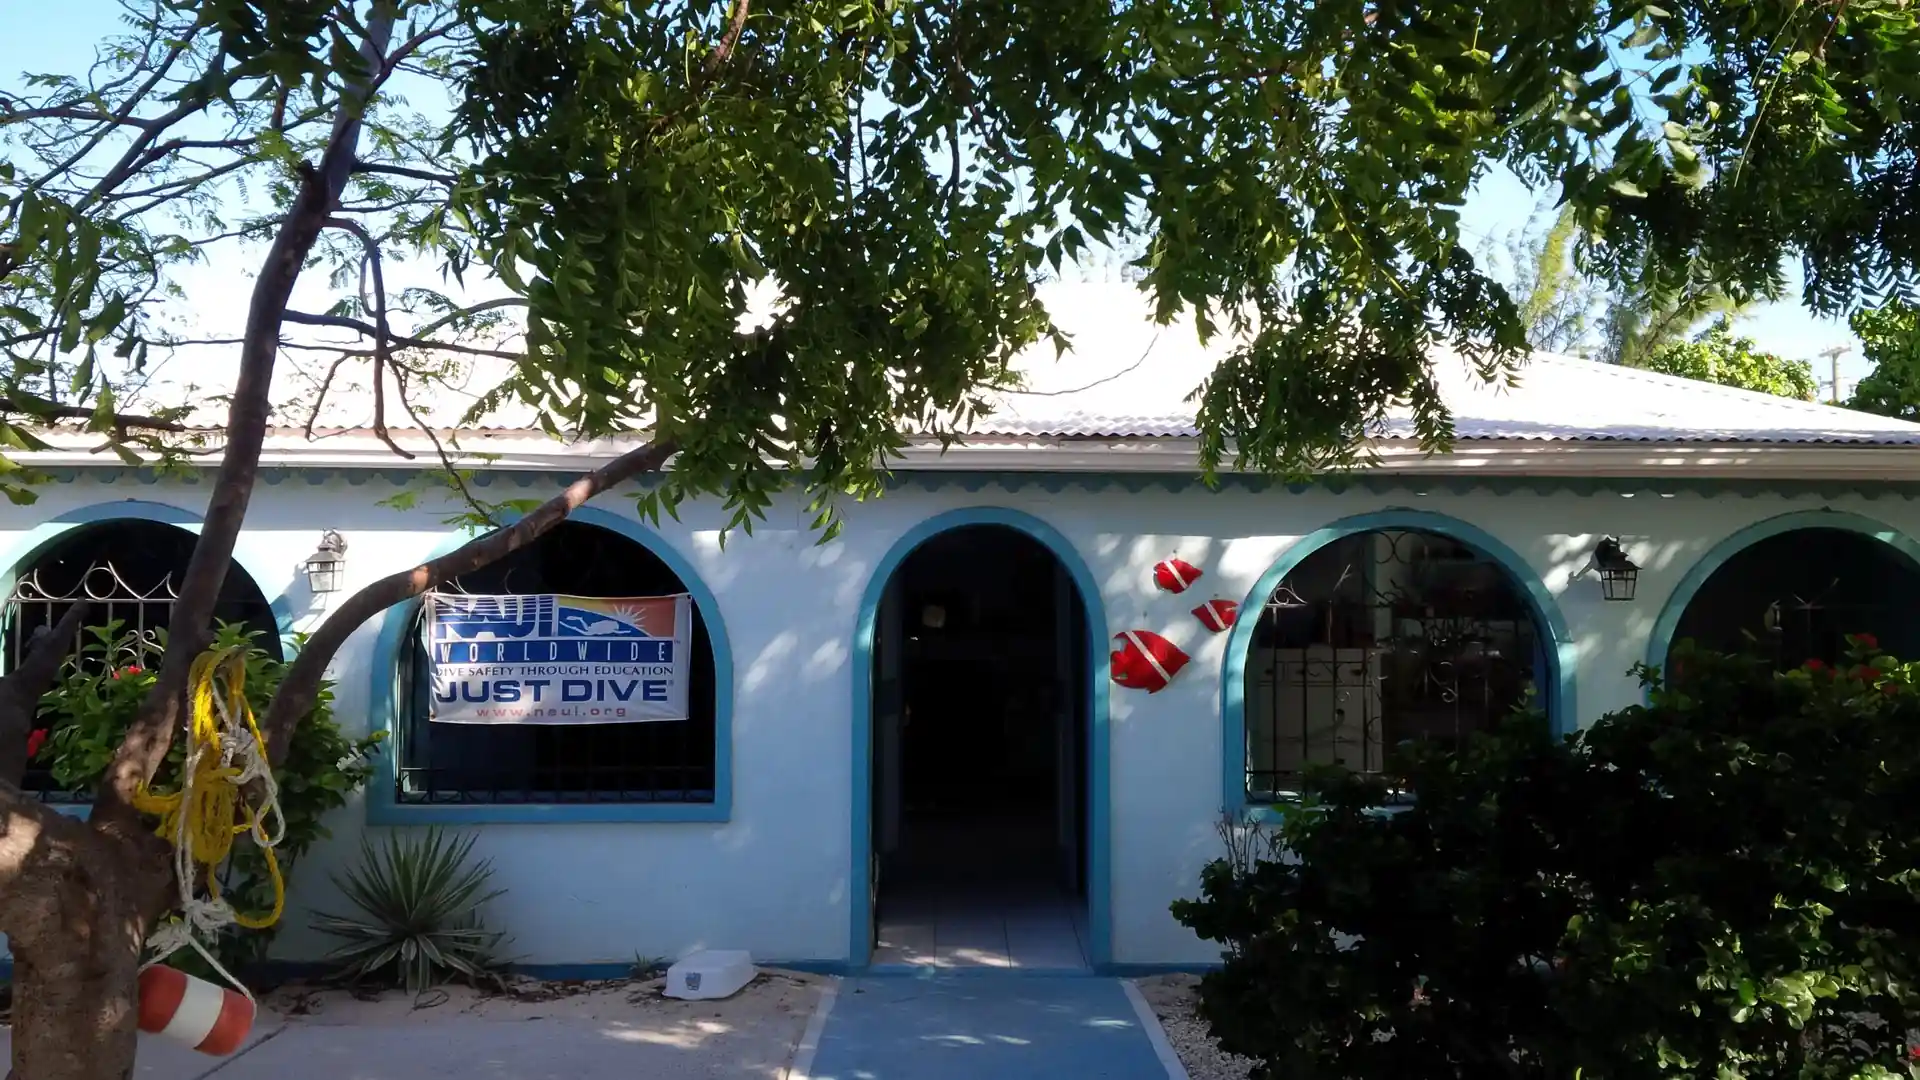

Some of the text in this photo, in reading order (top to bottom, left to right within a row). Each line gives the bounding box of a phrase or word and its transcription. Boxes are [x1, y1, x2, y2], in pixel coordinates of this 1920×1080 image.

[435, 596, 553, 639] NAUI
[440, 642, 666, 662] WORLDWIDE
[436, 666, 674, 677] DIVE SAFETY THROUGH EDUCATION
[435, 680, 668, 703] JUST DIVE
